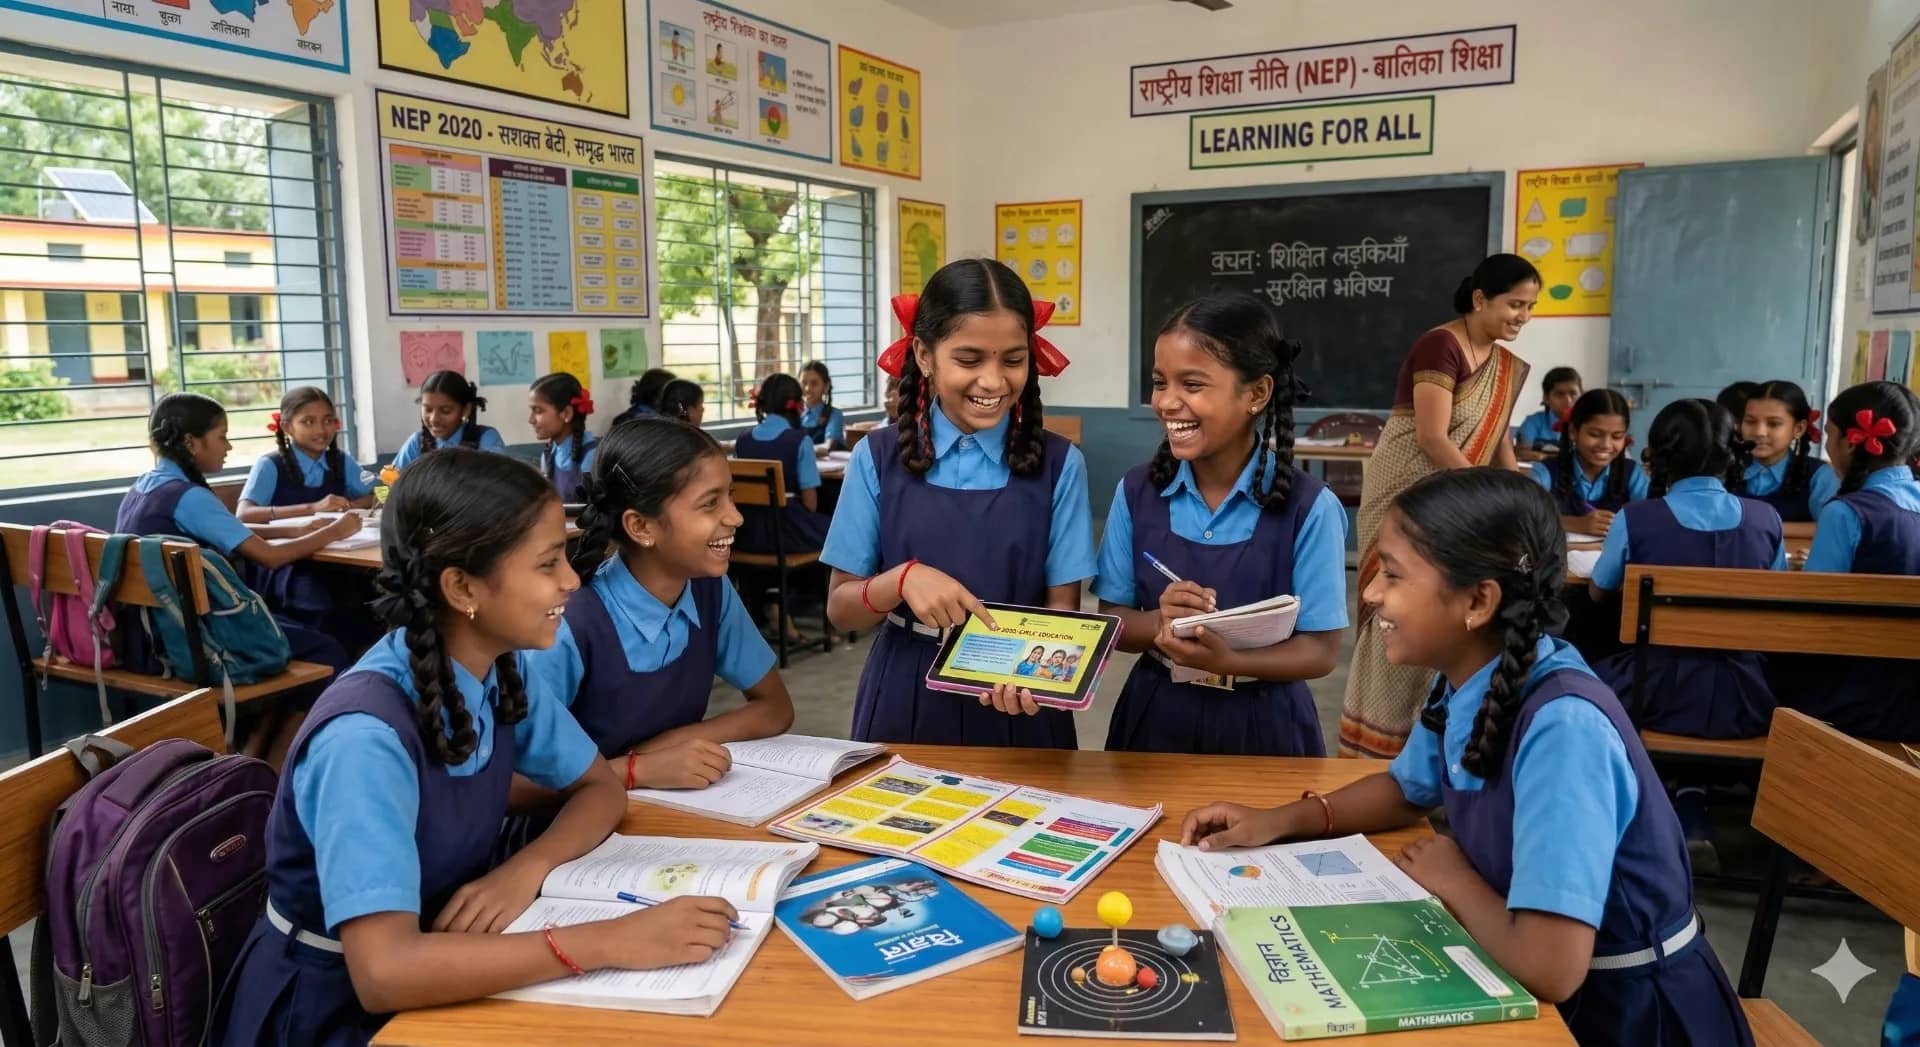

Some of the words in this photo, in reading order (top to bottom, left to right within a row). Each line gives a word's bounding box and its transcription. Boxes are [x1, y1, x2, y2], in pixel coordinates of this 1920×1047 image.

[1139, 69, 1192, 105] राष्ट्रीय
[1198, 65, 1242, 96] शिक्षा
[1249, 58, 1289, 91] नीति
[1296, 55, 1356, 93] (NEP)
[1373, 44, 1444, 80] बालिका
[1451, 38, 1504, 72] शिक्षा
[391, 105, 431, 132] NEP
[438, 113, 482, 140] 2020
[498, 125, 541, 149] सशक्त
[545, 126, 570, 157] बेटी,
[574, 138, 604, 165] समृद्ध
[608, 143, 635, 165] भारत
[1200, 121, 1313, 154] LEARNING
[1321, 117, 1369, 145] FOR
[1376, 114, 1421, 142] ALL
[1268, 241, 1328, 270] शिक्षित
[1333, 235, 1409, 269] लड़कियाँ
[1333, 271, 1394, 297] भविष्य
[1256, 942, 1296, 985] विज्ञान
[1270, 915, 1347, 1009] MATHEMATICS
[1398, 1011, 1474, 1028] MATHEMATICS
